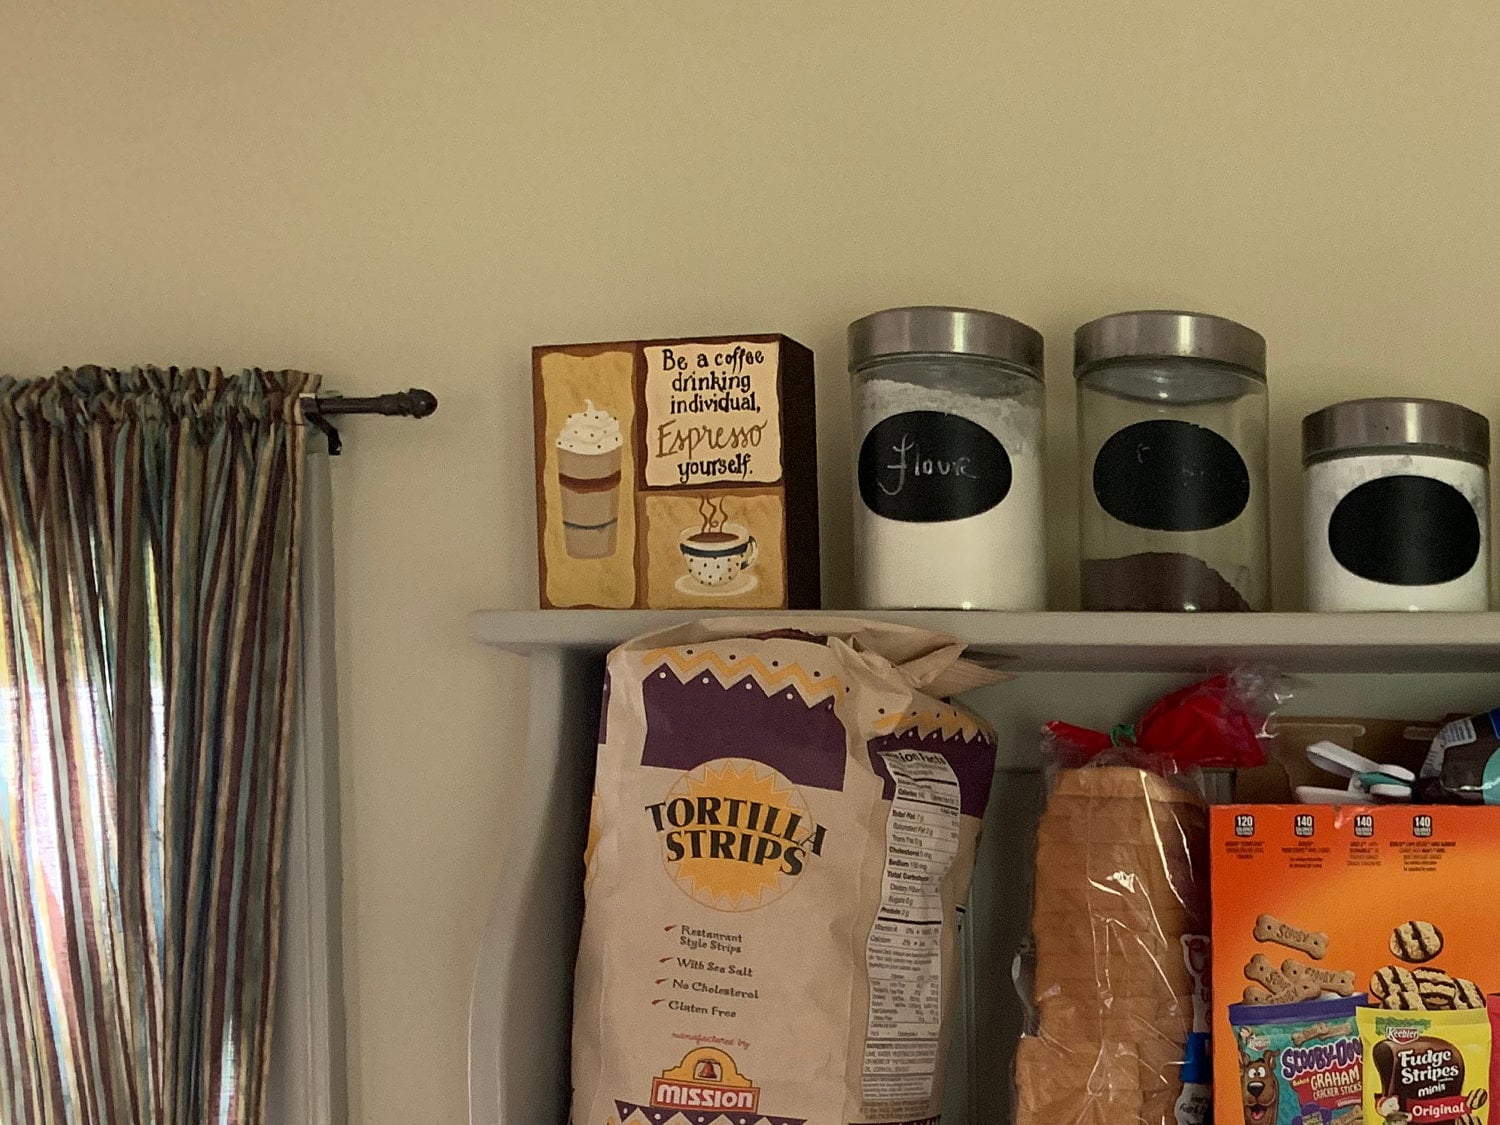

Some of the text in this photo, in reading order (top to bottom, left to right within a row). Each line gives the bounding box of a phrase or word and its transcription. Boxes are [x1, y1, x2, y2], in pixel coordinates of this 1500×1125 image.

[662, 346, 765, 374] Be a coffee
[672, 371, 751, 393] drinking
[671, 391, 761, 414] individual,
[656, 419, 768, 460] Espresso
[677, 453, 753, 484] yourself.
[645, 796, 828, 857] TORTILLA
[1296, 815, 1313, 827] 140
[1355, 815, 1373, 827] 140
[1414, 815, 1431, 827] 140
[666, 829, 806, 876] STRIPS
[681, 925, 743, 942] Restaurant
[680, 936, 742, 955] Style Strips
[677, 957, 753, 977] With Sea Salt
[672, 979, 759, 999] No Cholesterol
[668, 1000, 737, 1018] Gluten Free
[1389, 1026, 1417, 1039] Keebler
[1398, 1049, 1452, 1068] Fudge
[1311, 1066, 1361, 1091] GRAHAM
[1401, 1064, 1460, 1085] Stripes
[1418, 1082, 1447, 1098] minis
[1412, 1101, 1466, 1119] Original
